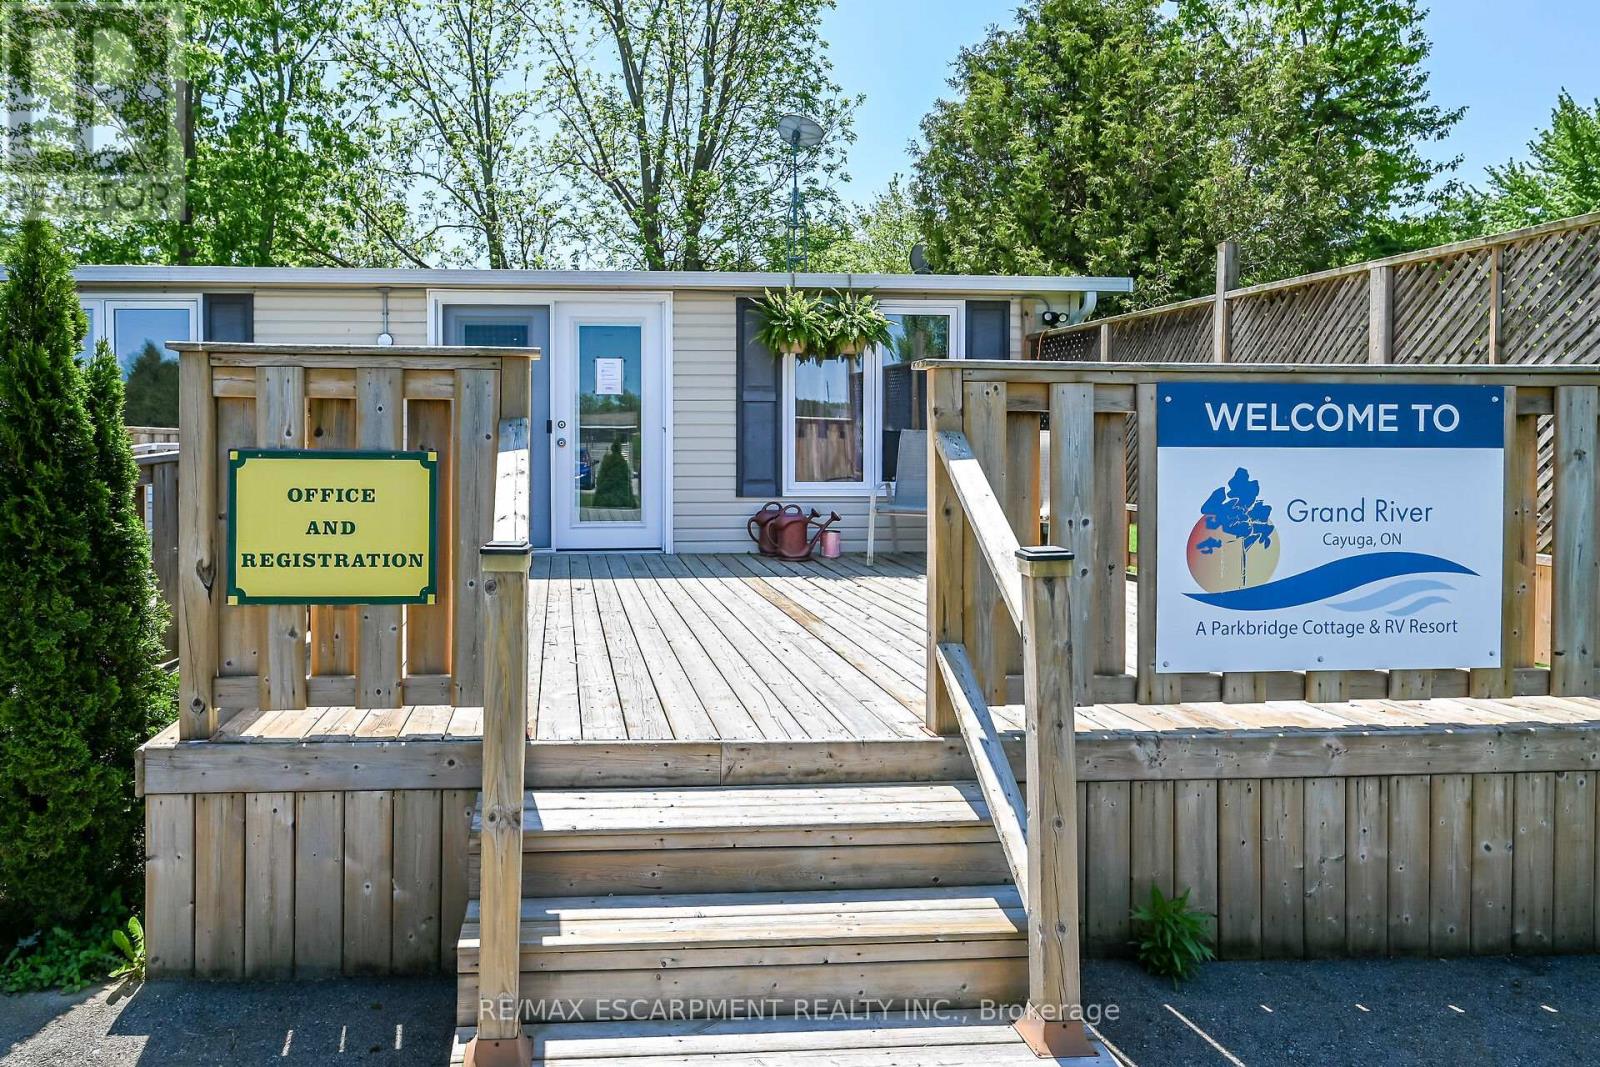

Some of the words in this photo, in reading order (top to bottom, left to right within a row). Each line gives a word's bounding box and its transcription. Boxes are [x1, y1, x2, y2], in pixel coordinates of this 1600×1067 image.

[1205, 402, 1398, 432] WELCOME
[1411, 404, 1460, 432] TO
[287, 488, 376, 503] OFFICE
[1286, 497, 1365, 522] Grand
[1376, 499, 1433, 522] River
[305, 521, 356, 535] AND
[1322, 532, 1377, 549] Cayuga,
[1380, 533, 1402, 546] ON
[241, 553, 424, 568] REGISTRATION
[1195, 622, 1207, 636] A
[1211, 620, 1298, 639] Parkbridge
[1302, 619, 1365, 637] Cottage
[1369, 619, 1381, 634] &
[1385, 619, 1405, 634] RV
[1409, 618, 1458, 634] Resort
